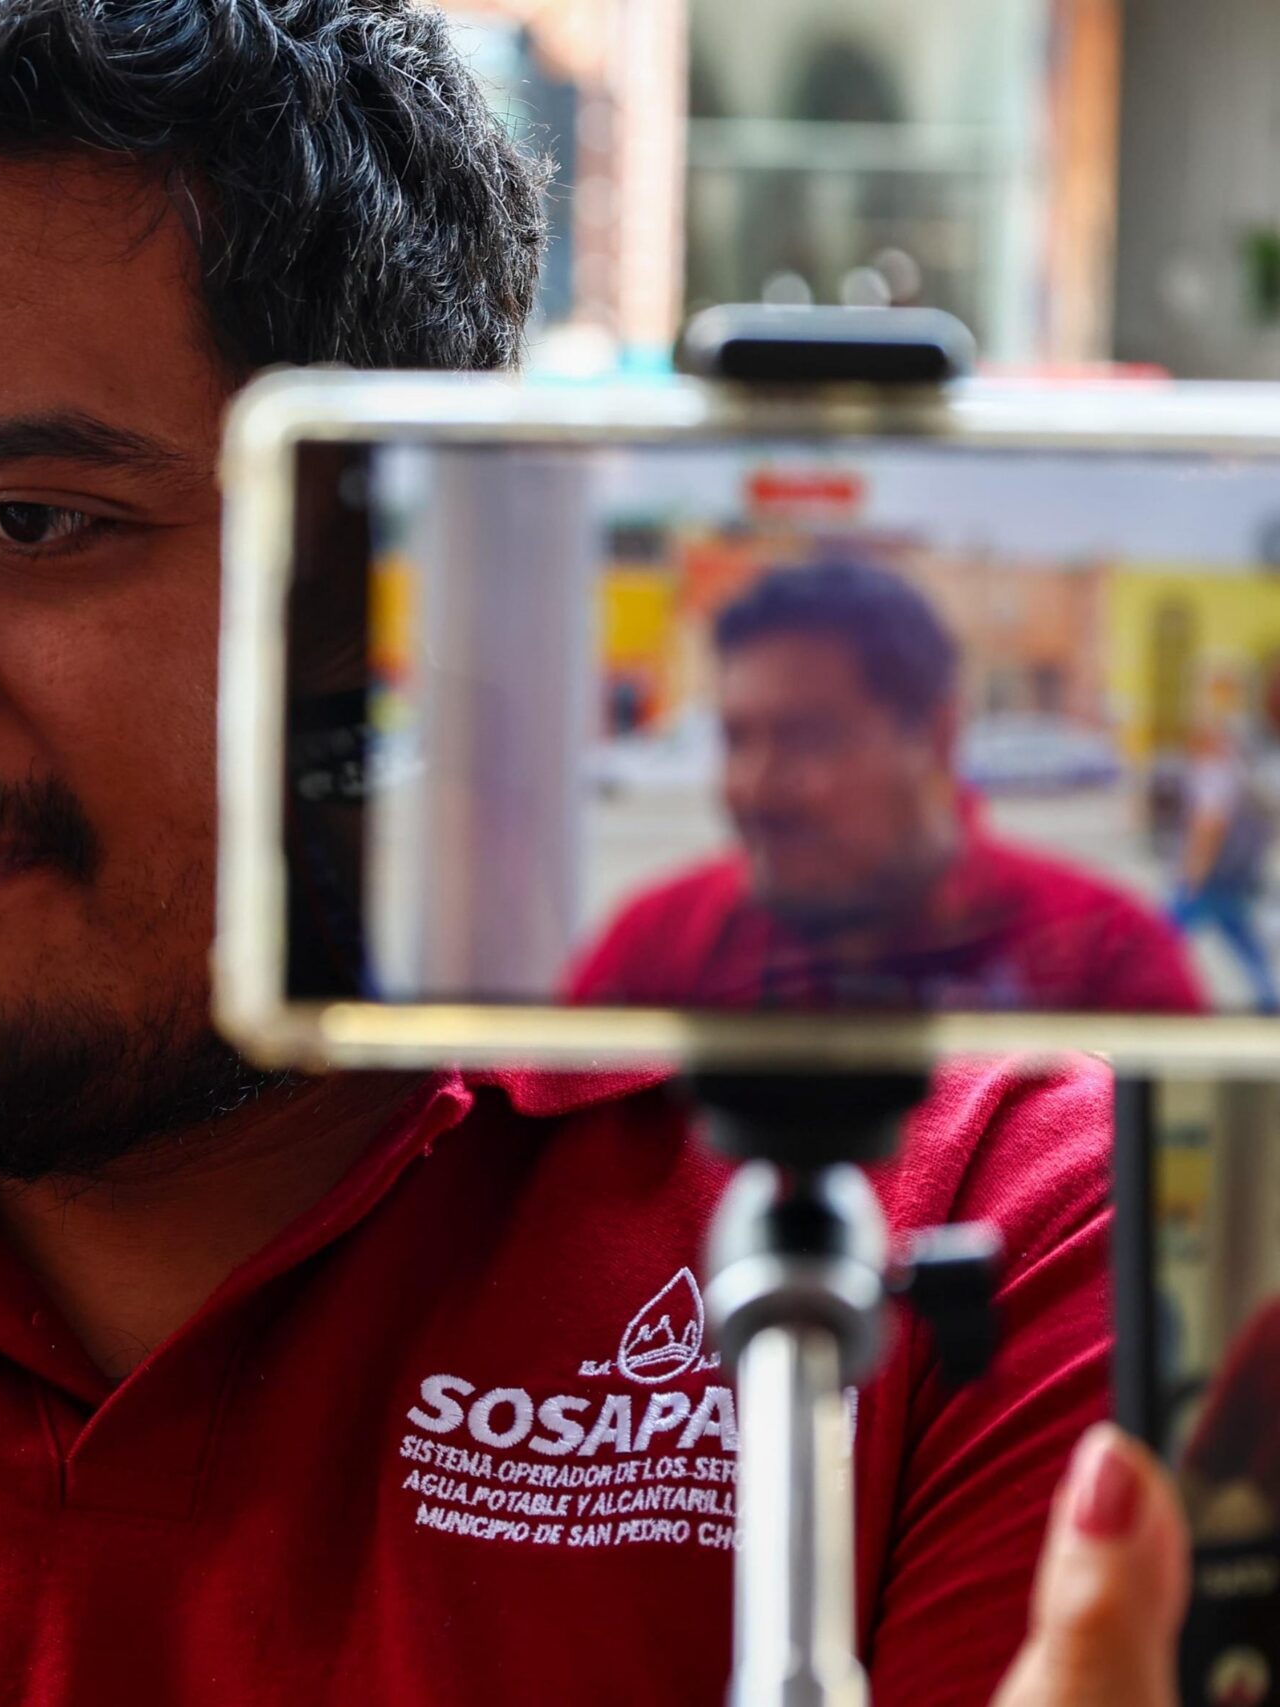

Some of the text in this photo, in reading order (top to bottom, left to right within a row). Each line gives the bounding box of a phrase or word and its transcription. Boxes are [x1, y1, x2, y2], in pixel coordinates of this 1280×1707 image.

[406, 1374, 742, 1456] SOSAPA
[399, 1435, 740, 1488] SISTEMA OPERADOR DE LOS SER
[402, 1469, 738, 1518] AGUA POTABLE Y ALCANTARILL
[415, 1501, 744, 1550] MUNICIPIO DE SAN PEDRO CHO
